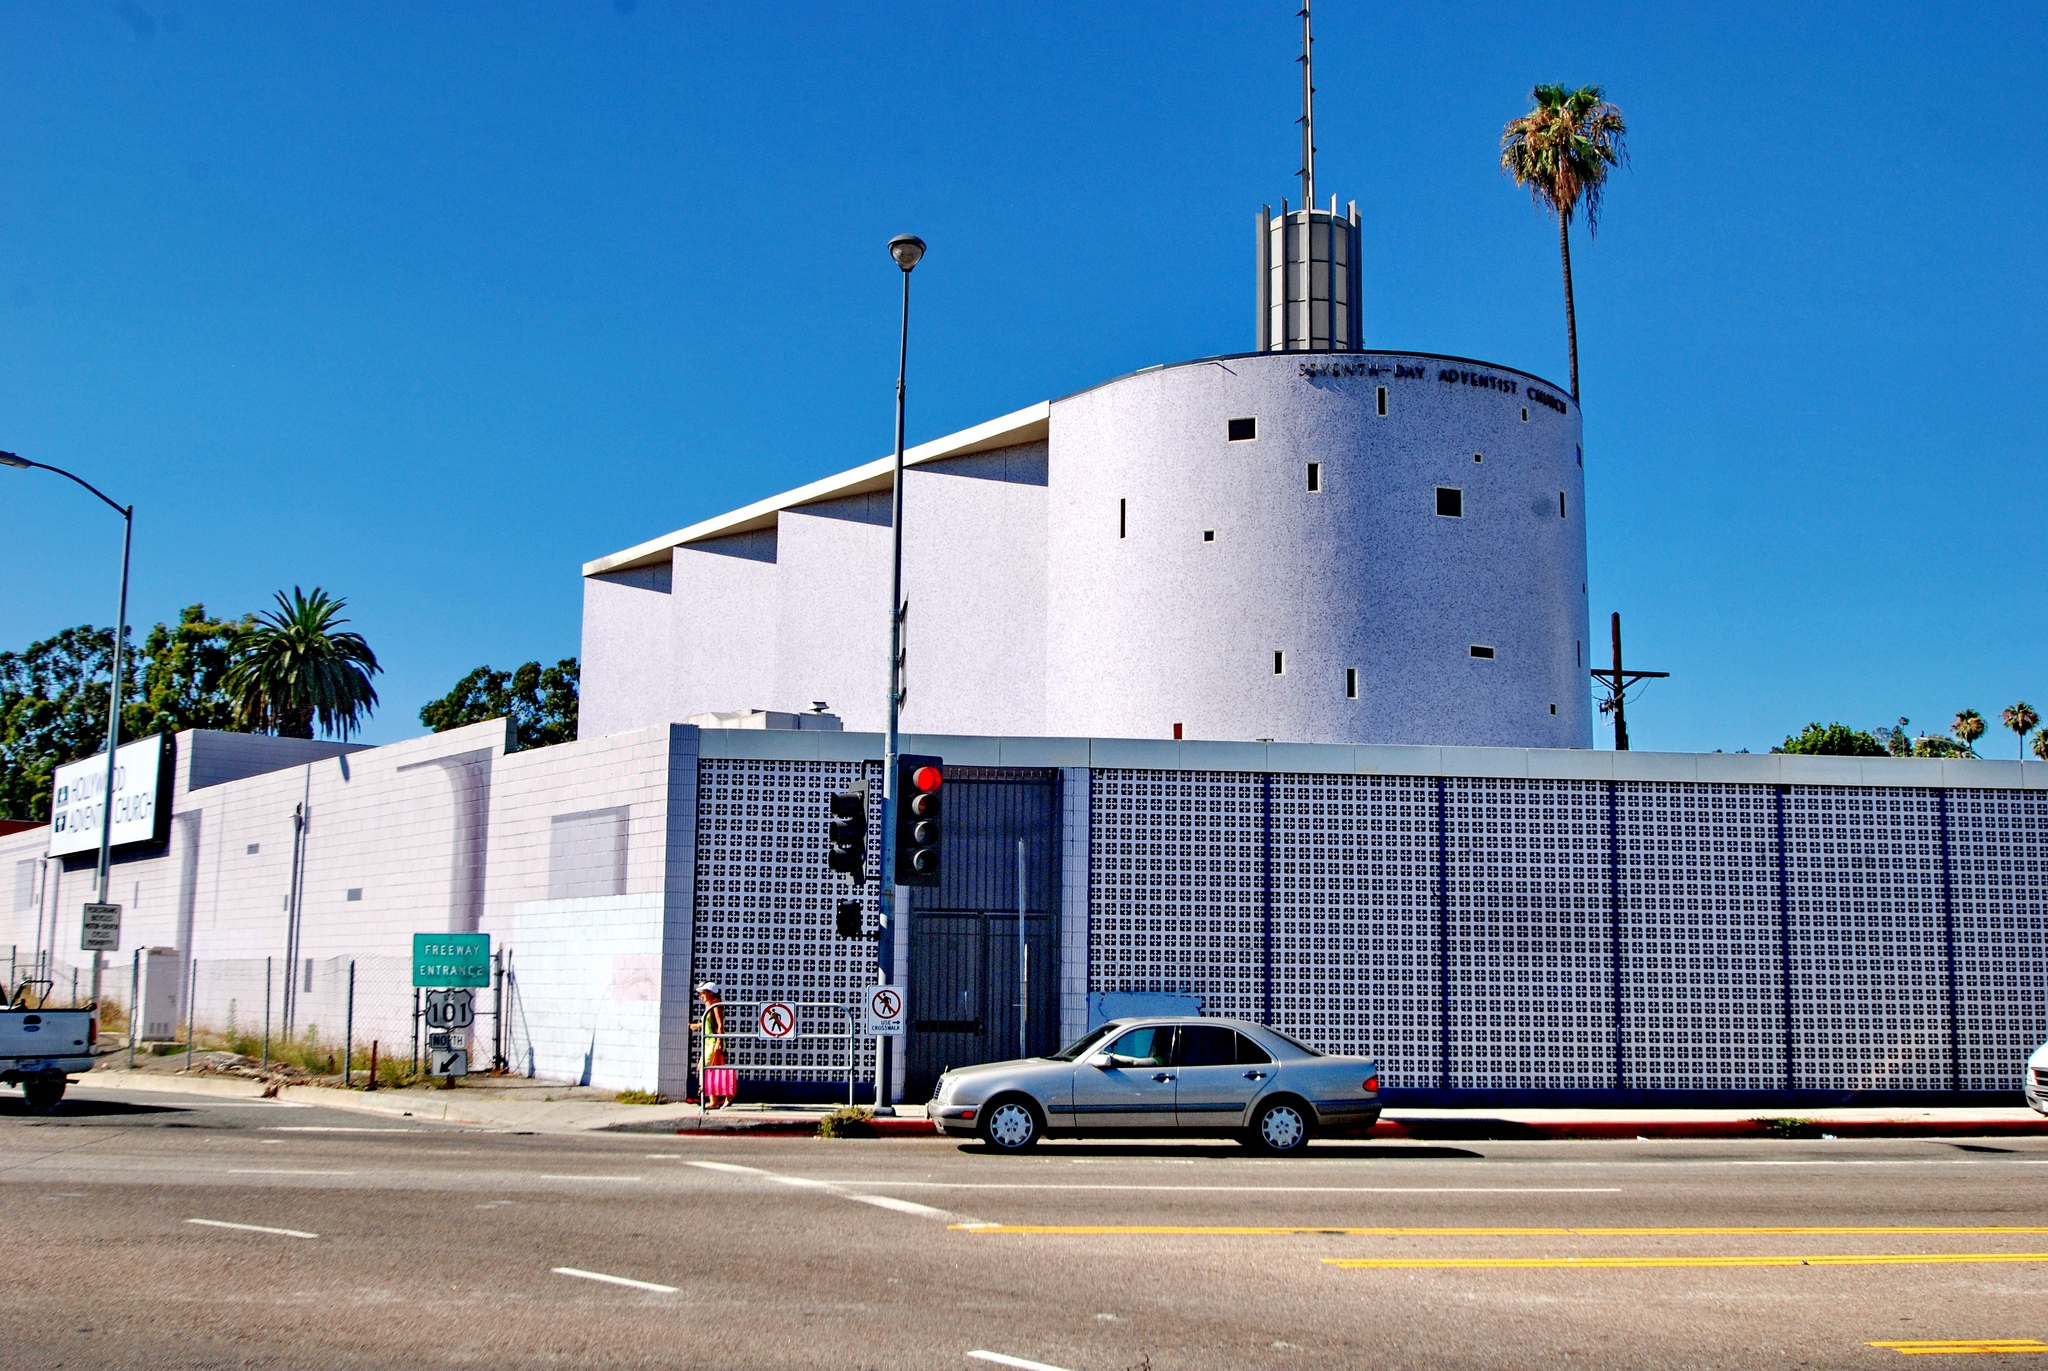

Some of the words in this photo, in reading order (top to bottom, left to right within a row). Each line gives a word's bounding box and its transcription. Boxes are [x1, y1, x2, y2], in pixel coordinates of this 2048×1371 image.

[1299, 363, 1426, 379] SEVENTH-DAY
[1439, 369, 1518, 394] ADVENTIST
[1527, 387, 1567, 414] CHURCH
[70, 765, 127, 804] HOLLYWOD
[115, 791, 154, 824] CHURCH
[425, 945, 480, 956] FREEWAY
[420, 965, 485, 976] ENTRANCE
[432, 1003, 466, 1022] 101
[433, 1036, 463, 1046] NORTH
